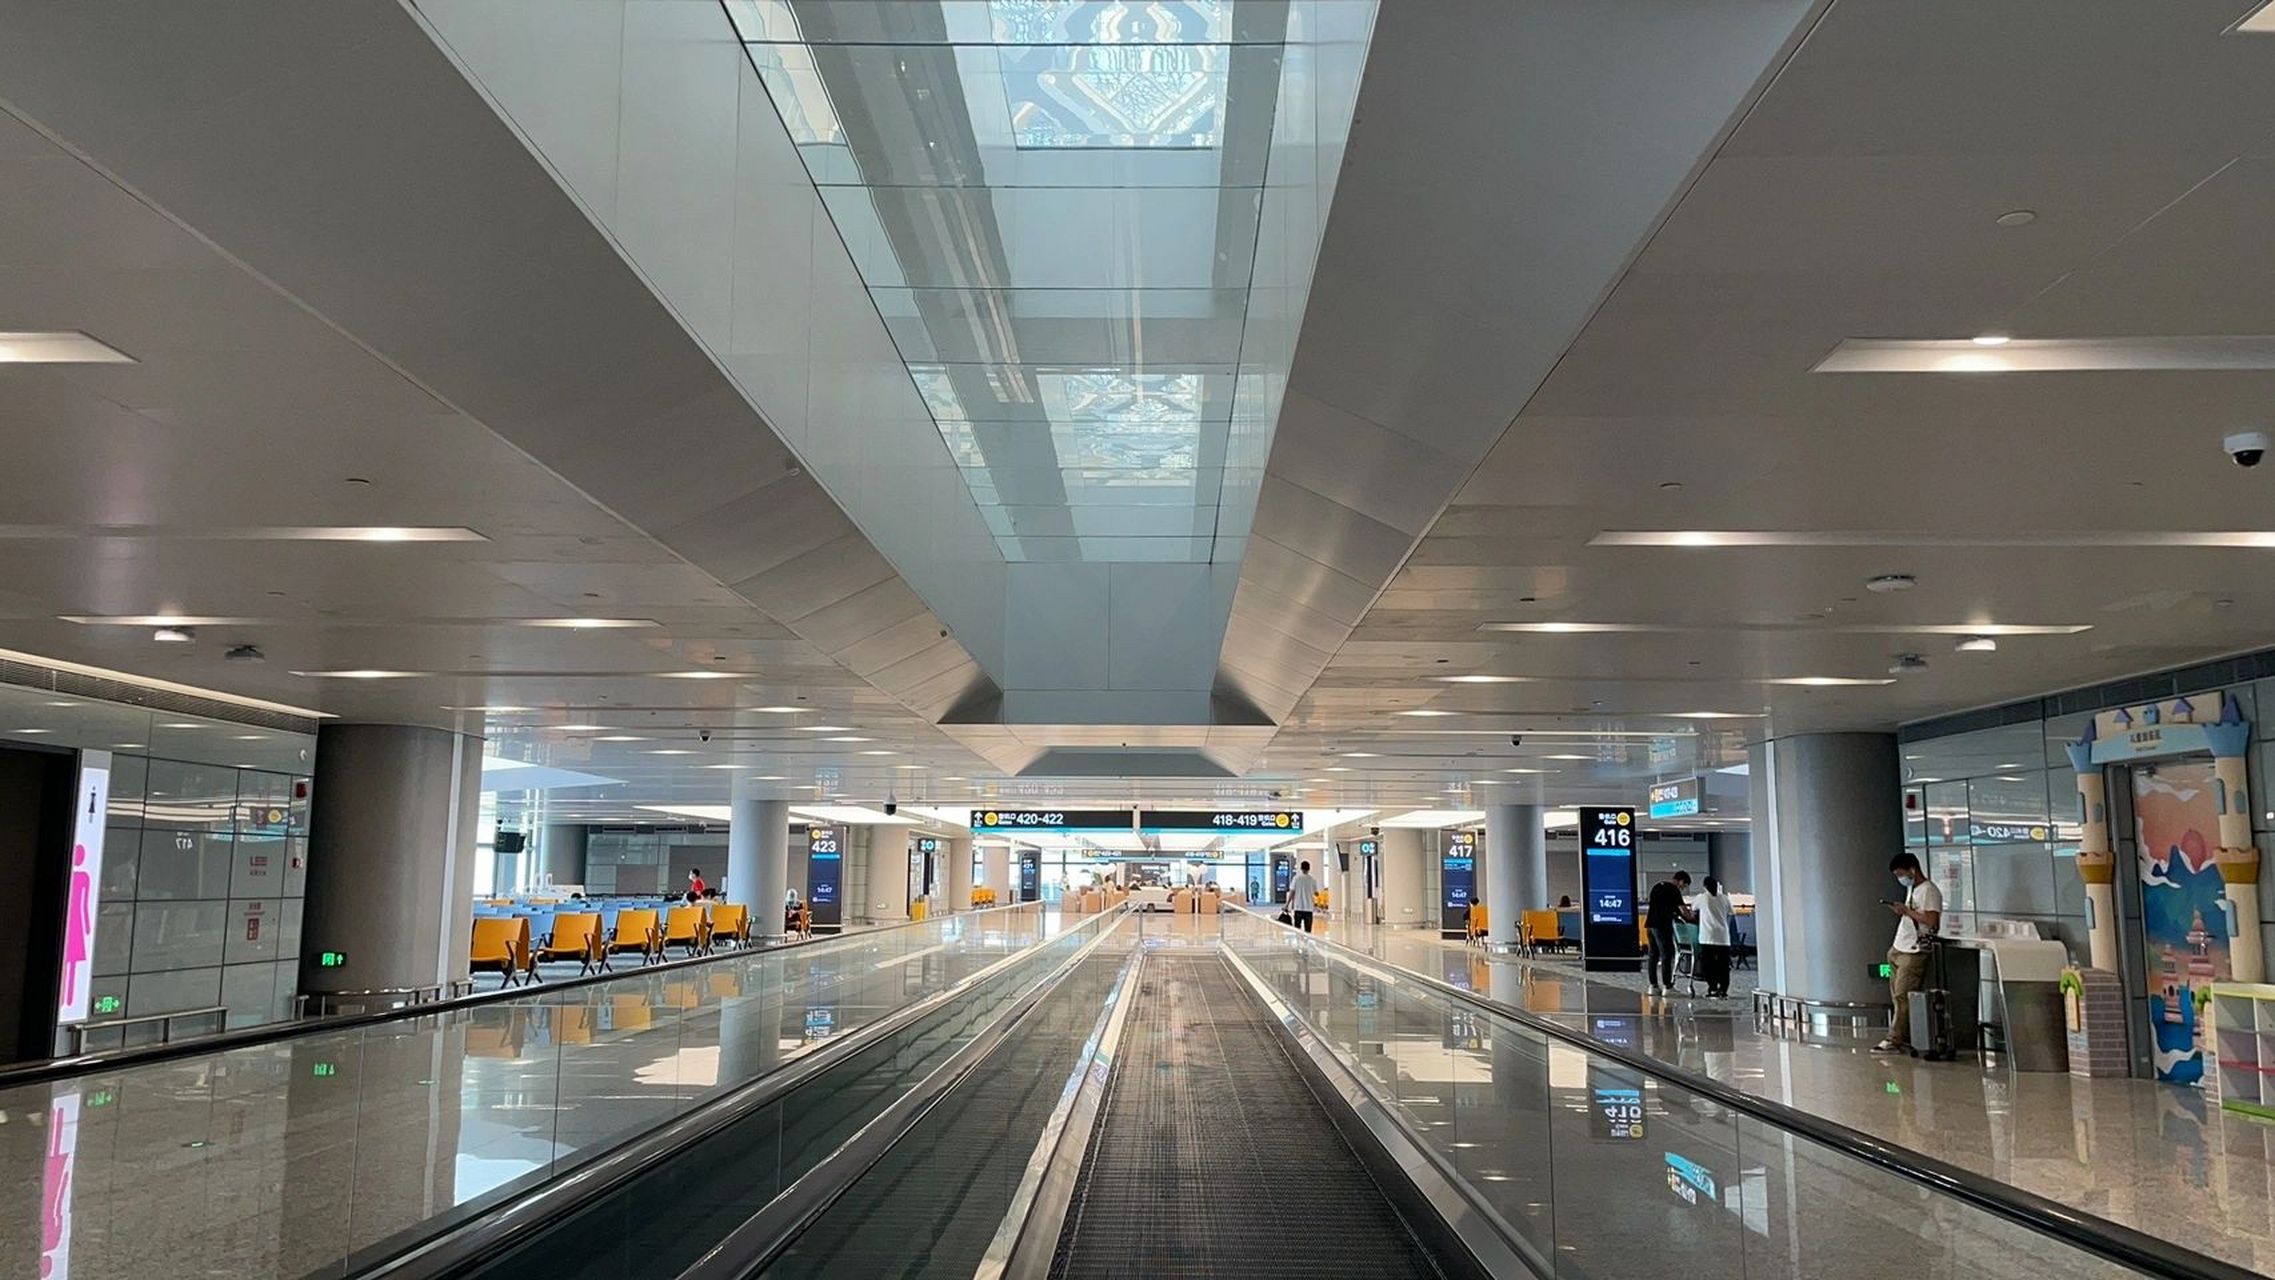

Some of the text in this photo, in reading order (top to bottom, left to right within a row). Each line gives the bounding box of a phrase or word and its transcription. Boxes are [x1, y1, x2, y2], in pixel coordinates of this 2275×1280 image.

[1016, 813, 1064, 825] 420-422
[1212, 814, 1258, 826] 418-419
[1594, 828, 1631, 847] 416
[811, 840, 836, 853] 423
[1448, 845, 1473, 857] 417
[1599, 899, 1622, 908] 14:47
